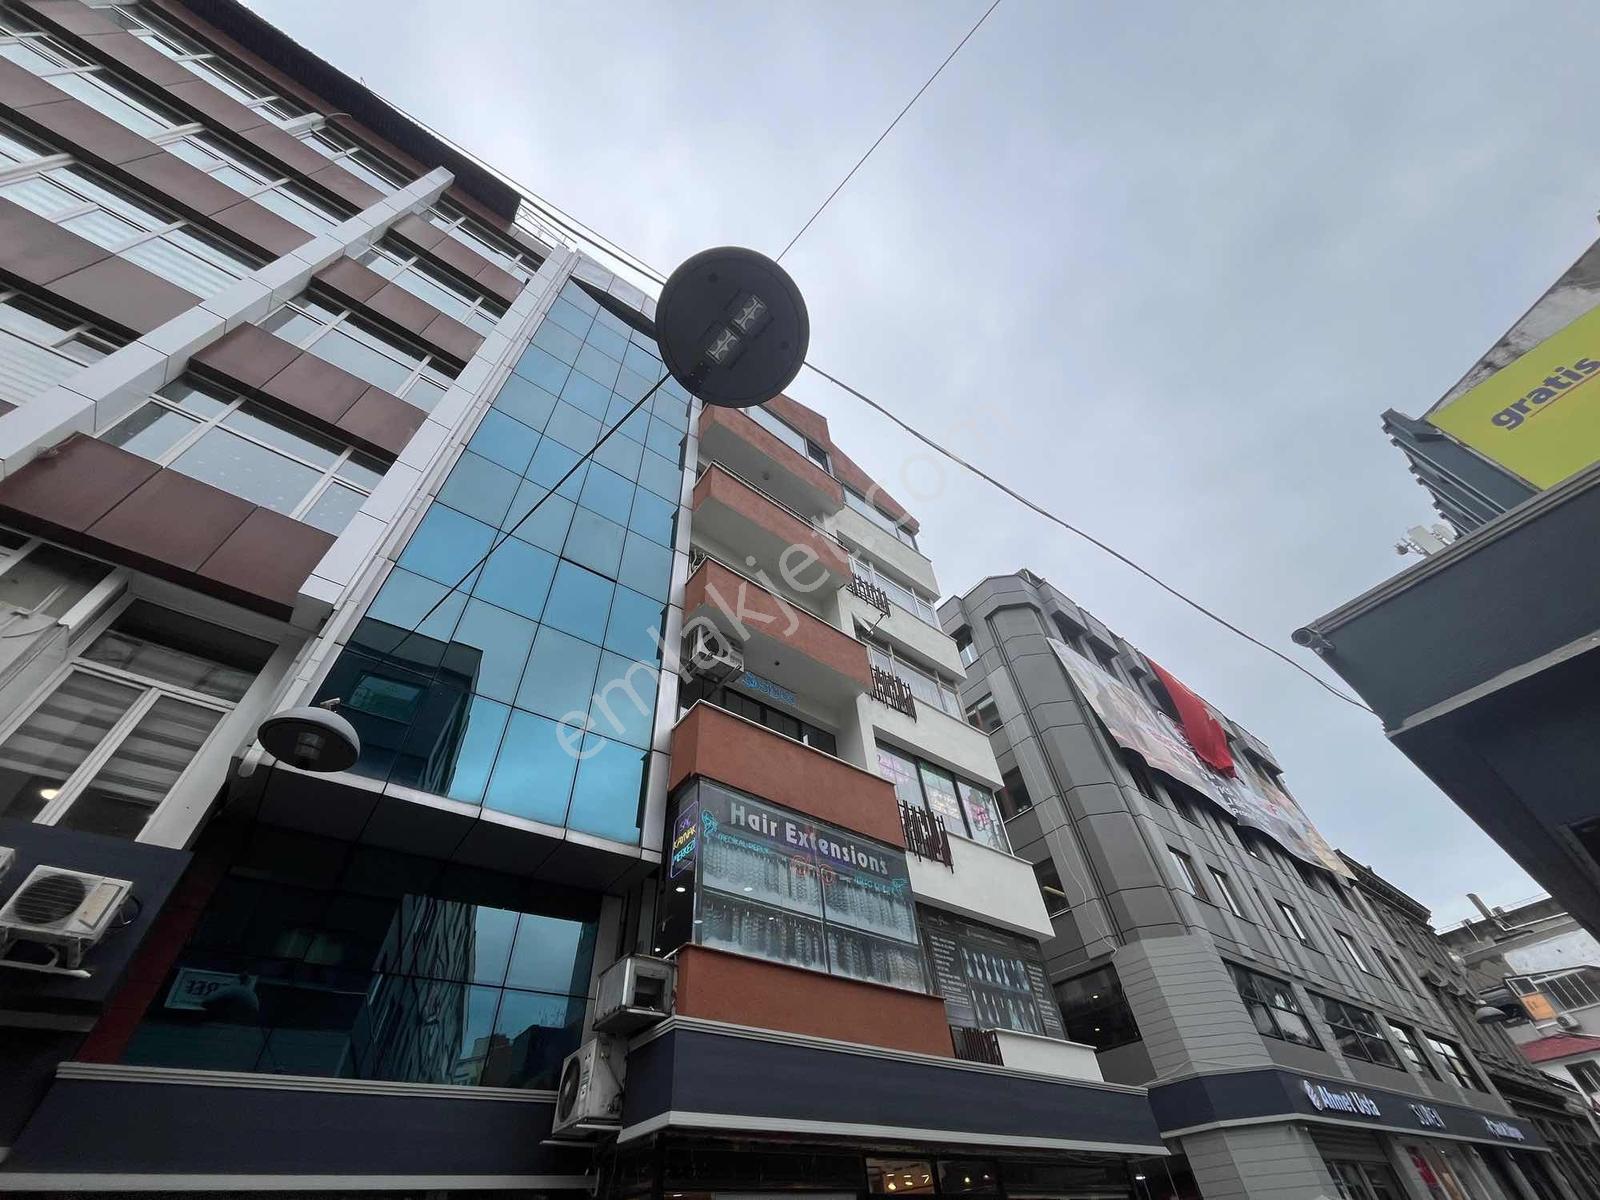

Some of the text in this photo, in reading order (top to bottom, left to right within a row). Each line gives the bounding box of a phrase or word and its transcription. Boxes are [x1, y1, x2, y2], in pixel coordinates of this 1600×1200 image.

[1490, 357, 1600, 431] gratis
[730, 801, 889, 875] Hair Extensions
[1316, 1085, 1381, 1116] Ahmet Usta
